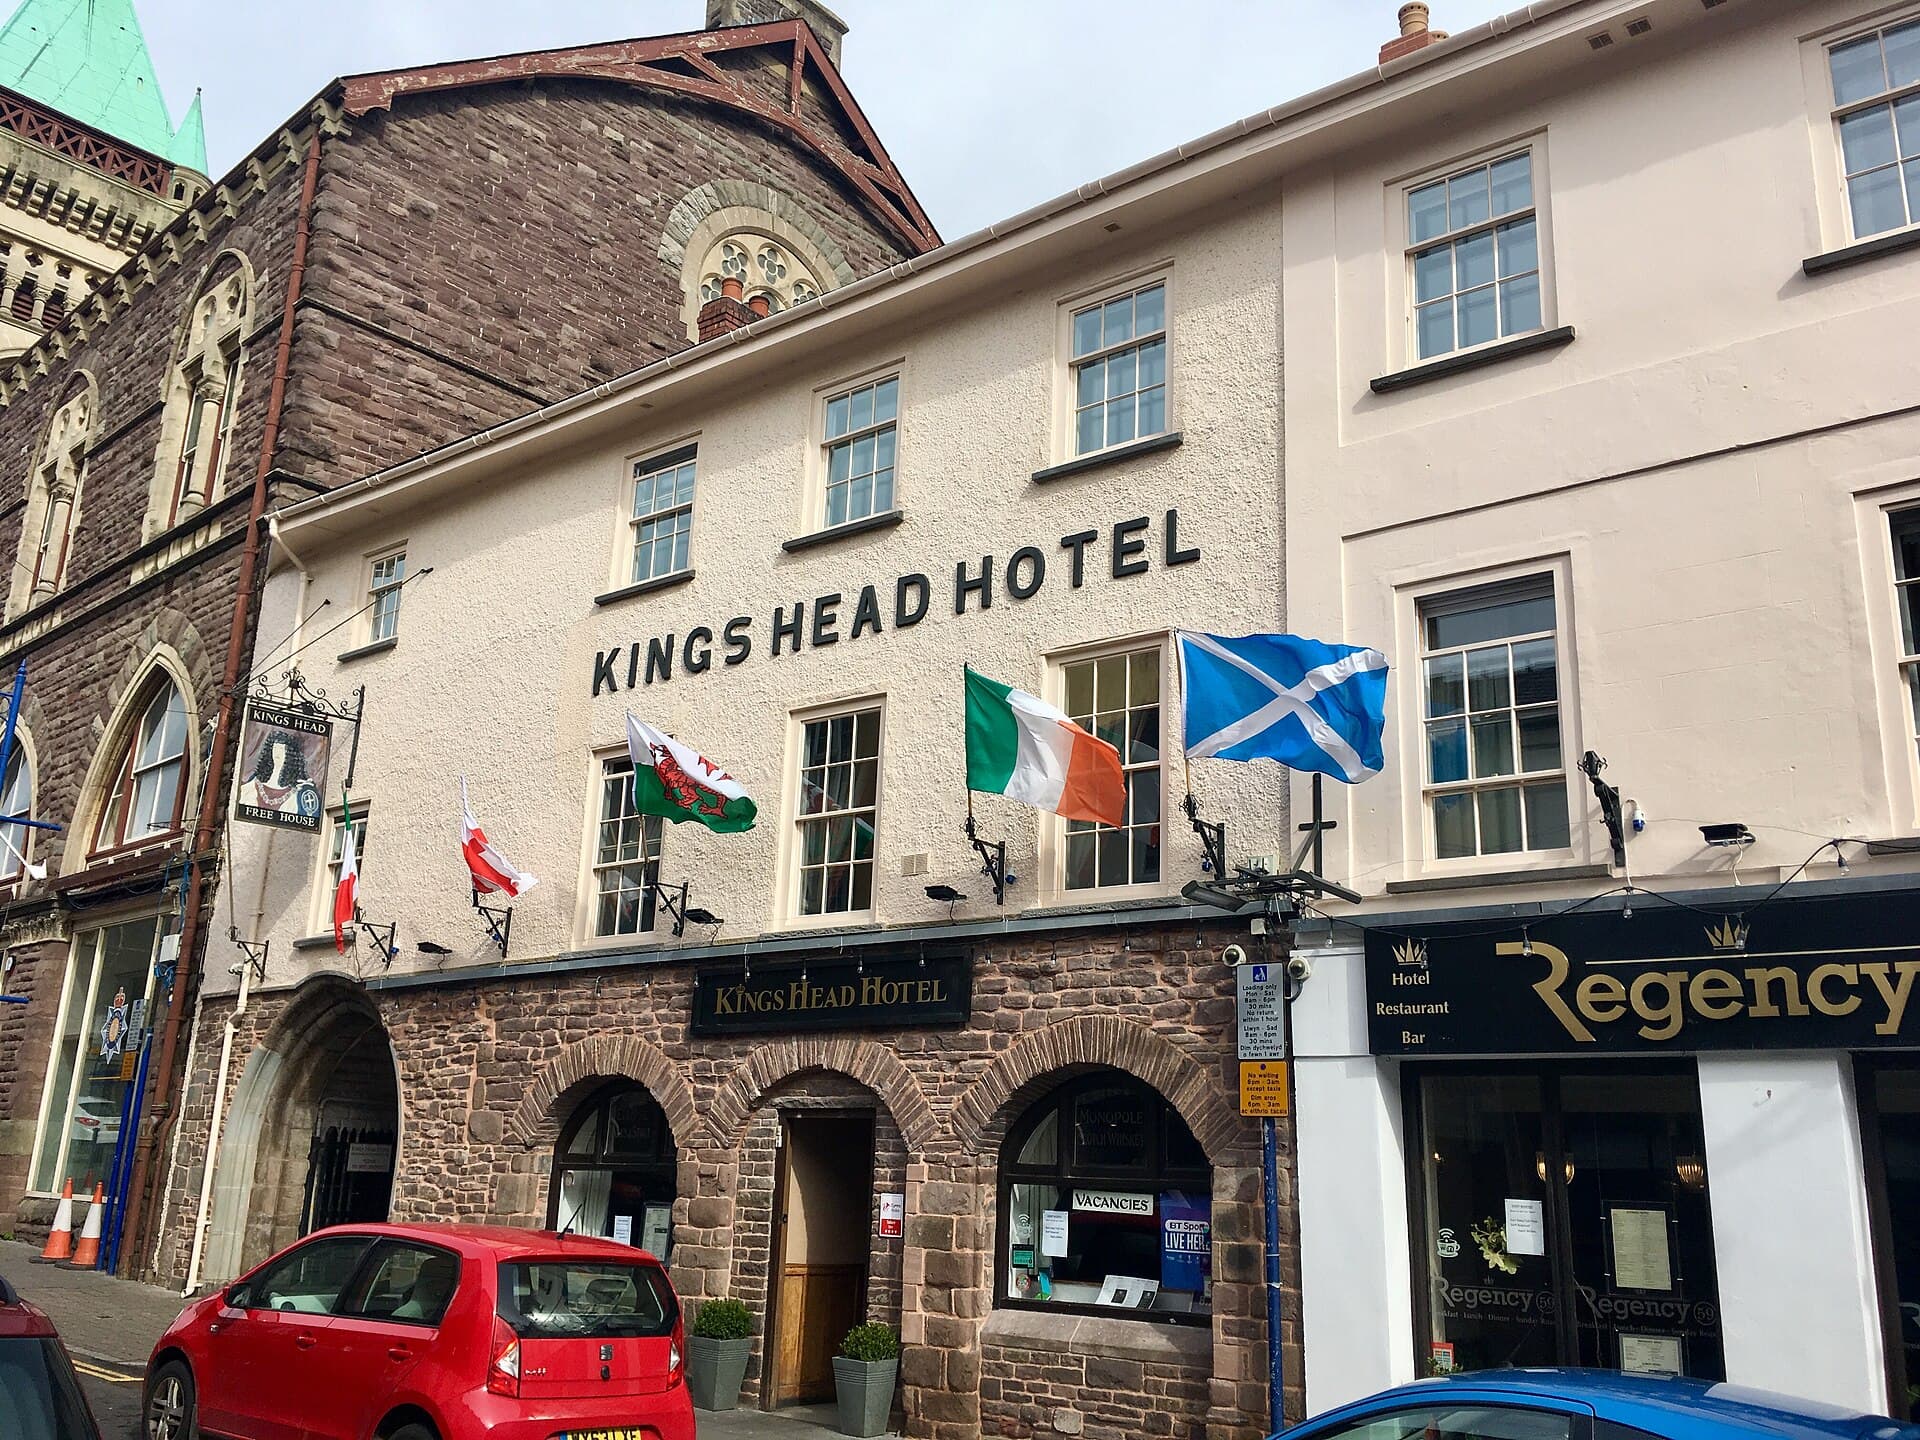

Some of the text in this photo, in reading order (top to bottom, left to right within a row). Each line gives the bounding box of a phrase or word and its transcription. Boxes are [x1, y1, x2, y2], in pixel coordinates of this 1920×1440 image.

[593, 509, 1200, 696] KINGS HEAD HOTEL
[253, 710, 326, 734] KINGS HEAD
[245, 806, 315, 826] FREE HOUSE
[1392, 970, 1430, 986] Hotel
[1496, 941, 1920, 1042] Regency
[1376, 1001, 1450, 1015] Restaurant
[1402, 1031, 1426, 1044] Bar
[1079, 1107, 1144, 1125] MONOPOLE
[1075, 1193, 1149, 1212] VACANCIES
[1169, 1222, 1183, 1230] BT
[1165, 1232, 1185, 1249] LIVE
[1431, 1276, 1535, 1313] Regency
[1577, 1286, 1714, 1324] Regency 59
